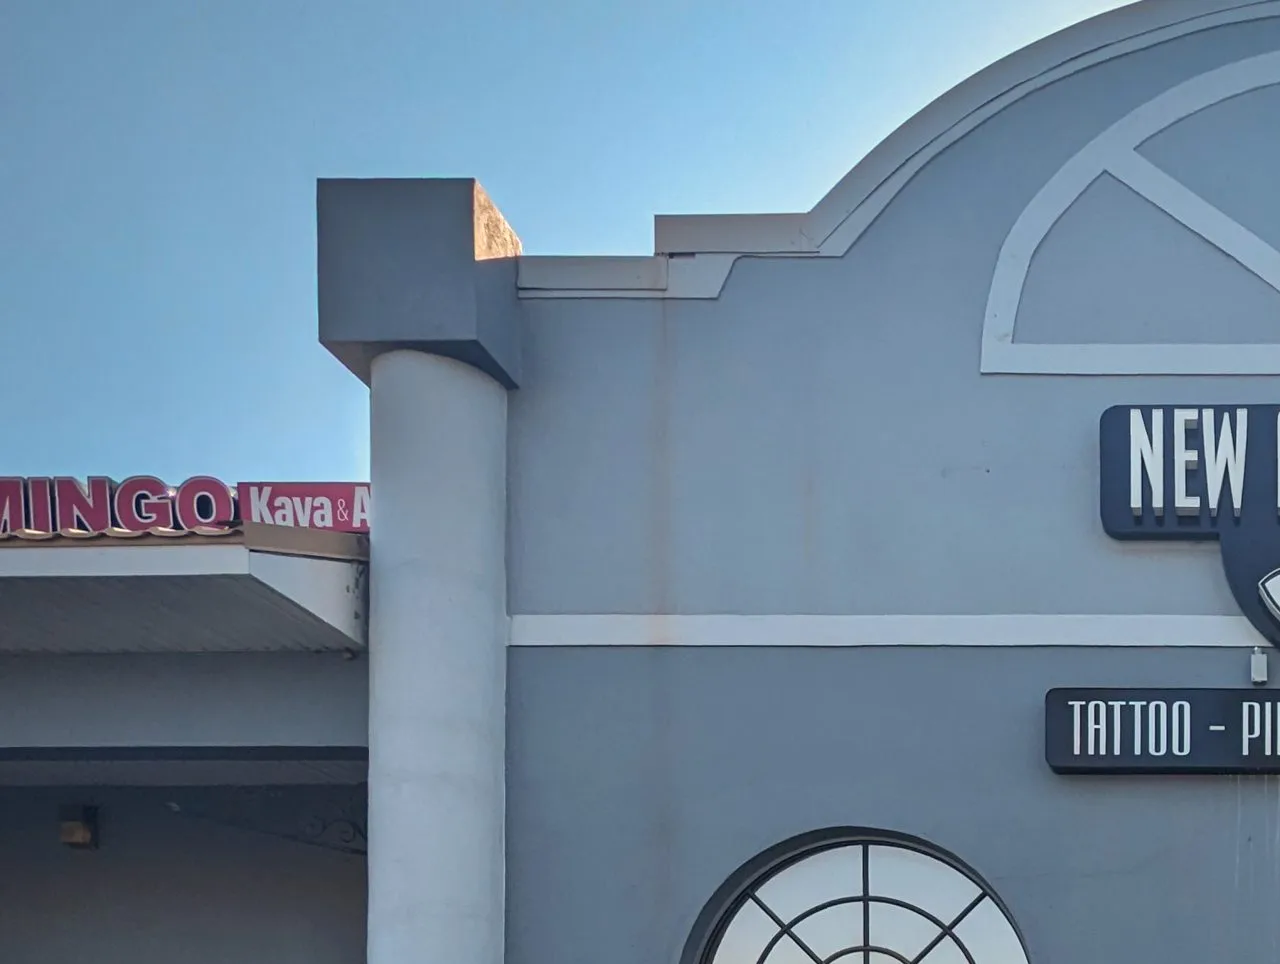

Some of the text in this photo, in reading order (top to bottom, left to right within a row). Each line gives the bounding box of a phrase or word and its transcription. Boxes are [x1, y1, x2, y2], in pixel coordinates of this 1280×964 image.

[1130, 407, 1248, 517] NEW
[249, 486, 333, 528] Kava
[1067, 700, 1192, 756] TATTOO
